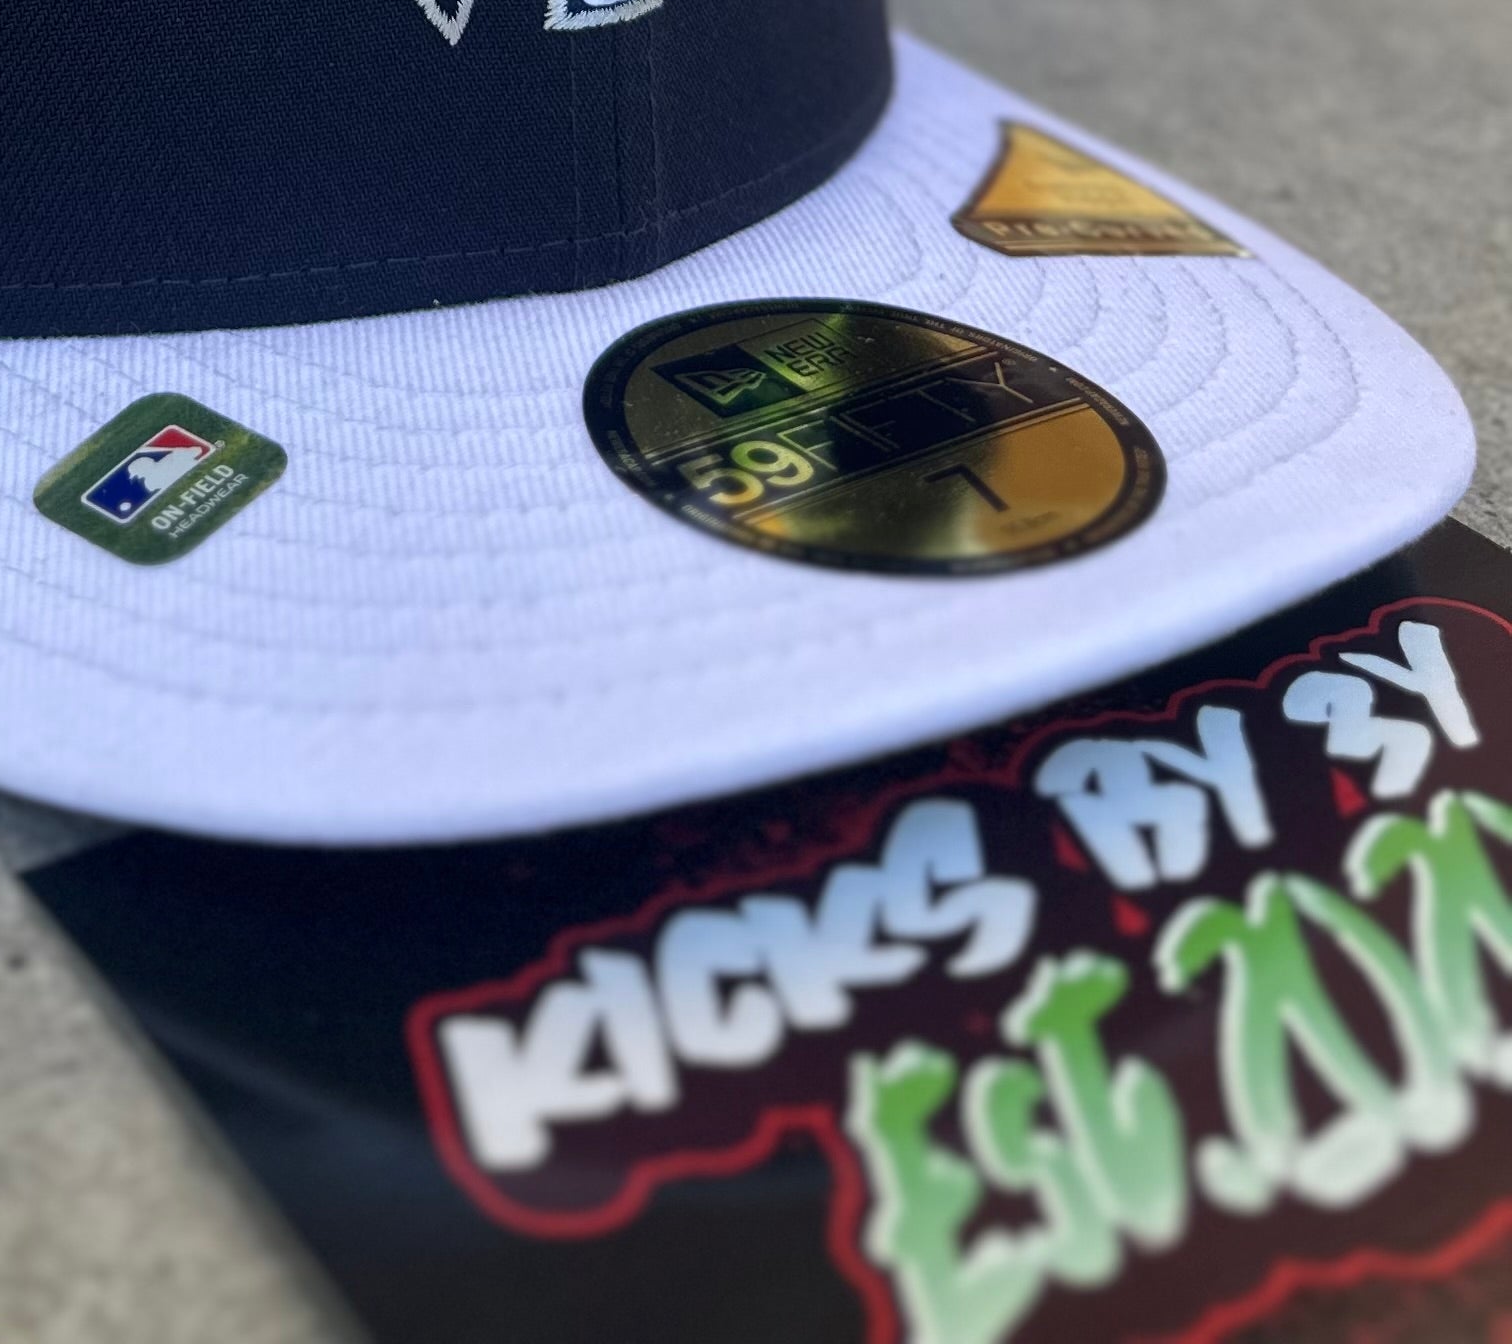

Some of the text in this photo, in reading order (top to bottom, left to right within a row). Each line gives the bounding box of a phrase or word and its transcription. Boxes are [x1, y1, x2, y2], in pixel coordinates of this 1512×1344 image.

[764, 331, 835, 364] NEW
[784, 346, 859, 378] ERA
[151, 464, 234, 530] ON-FIELD
[168, 472, 250, 539] HEADWEAR
[438, 796, 1039, 1169] KICKS
